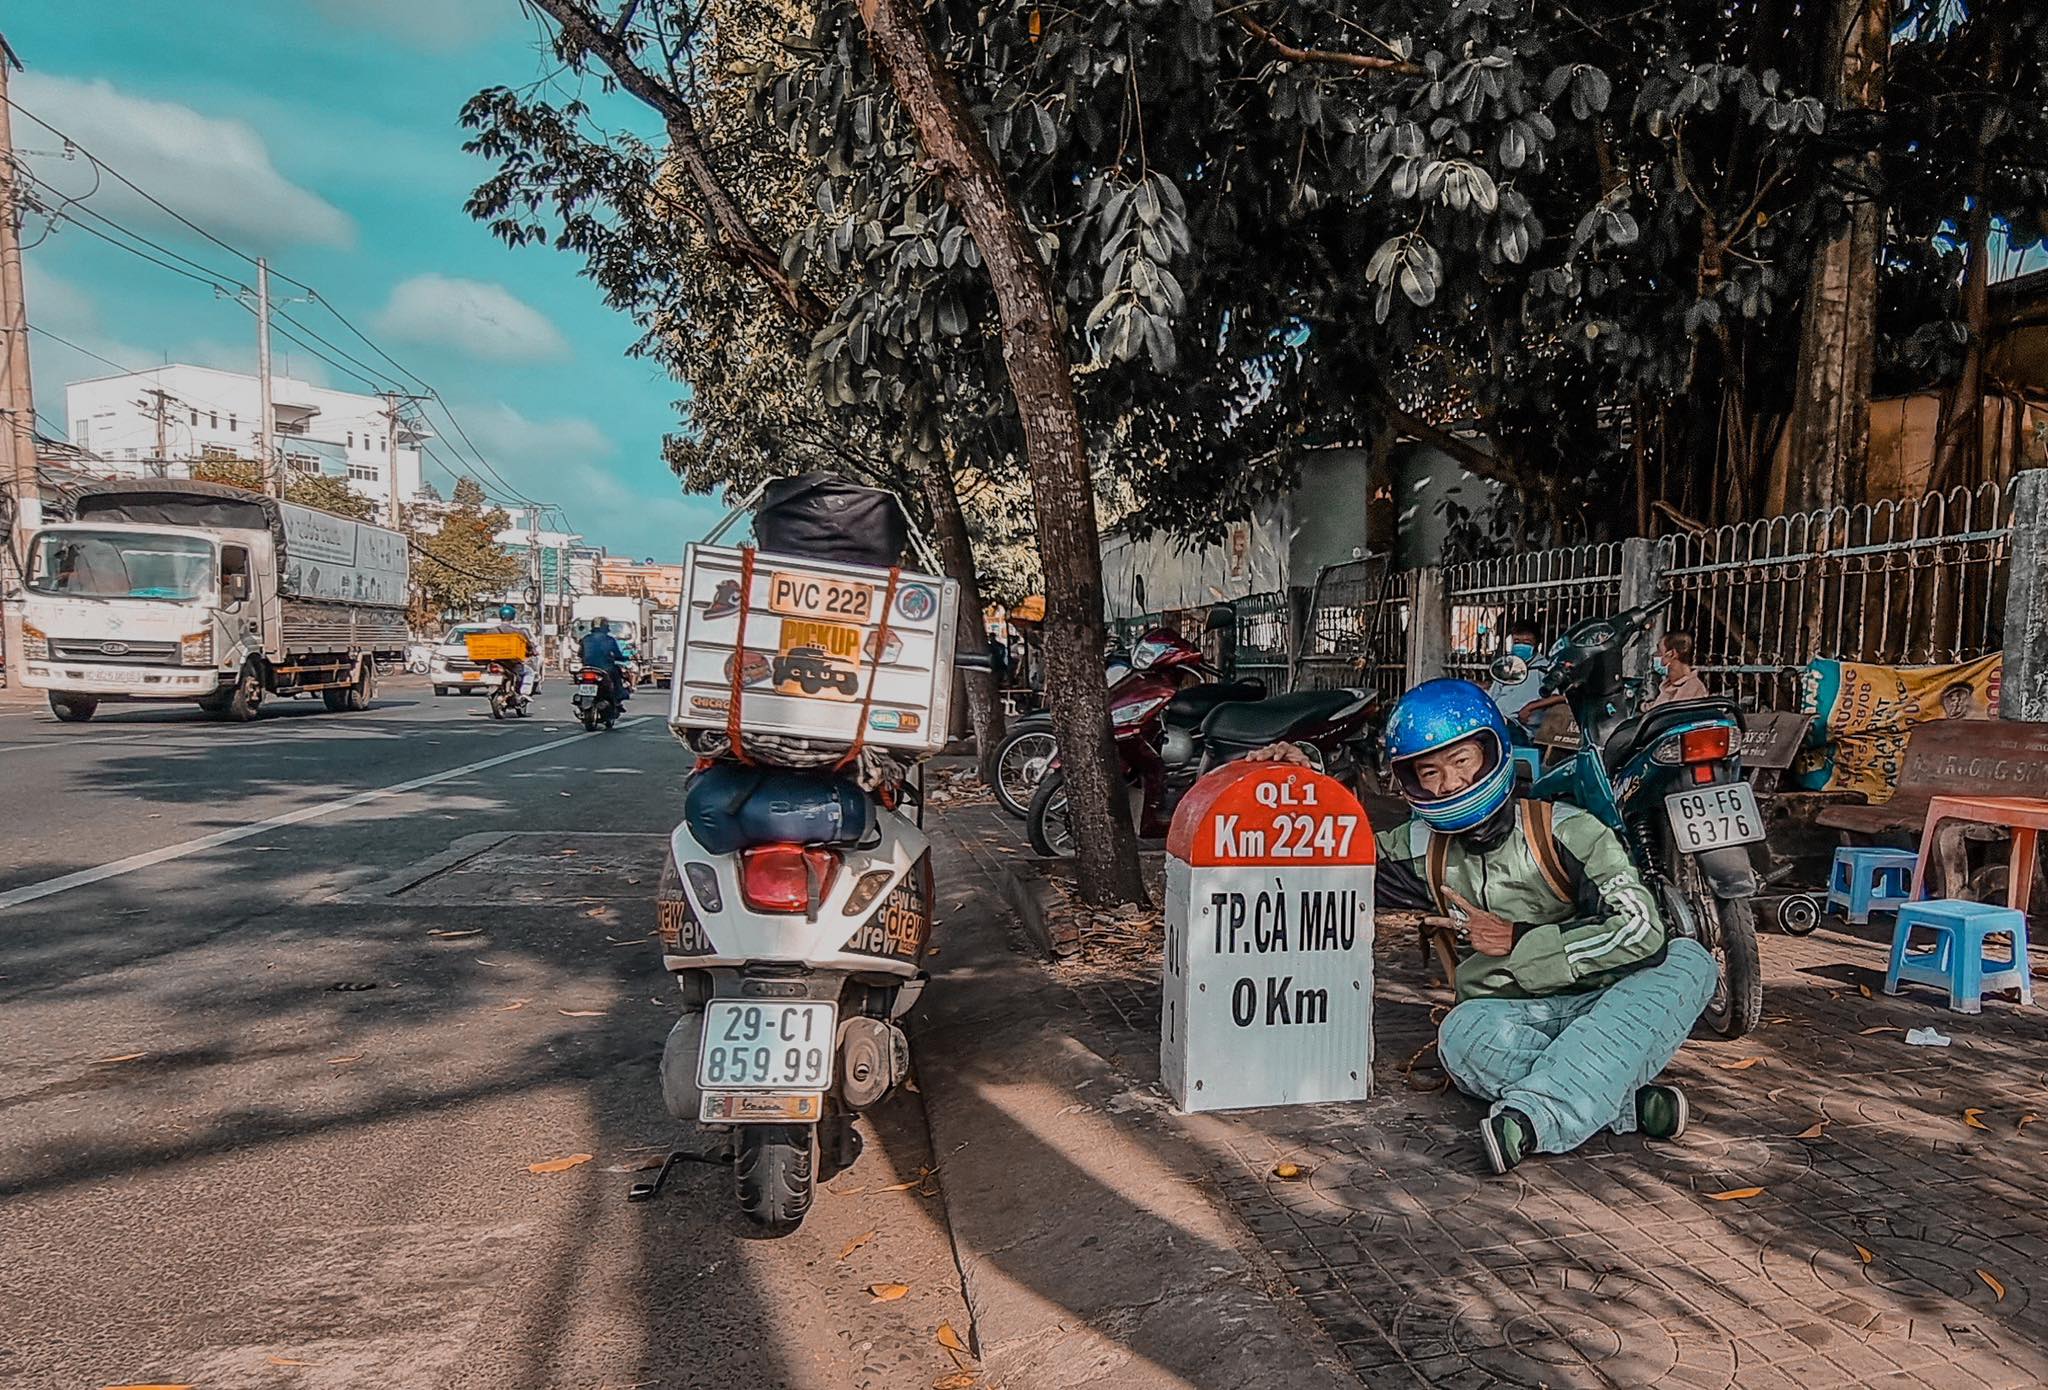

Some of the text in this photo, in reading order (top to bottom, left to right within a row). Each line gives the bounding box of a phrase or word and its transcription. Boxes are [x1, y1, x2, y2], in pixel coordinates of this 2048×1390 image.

[776, 580, 867, 615] PVC 222
[782, 621, 860, 656] PICKUP
[791, 668, 847, 682] CLUB
[691, 696, 731, 709] CHICAG
[1680, 789, 1742, 820] 69-F6
[1215, 815, 1358, 858] Km 2247
[1687, 815, 1750, 846] 6376
[1299, 890, 1357, 951] MAU
[723, 1006, 814, 1042] 29-C1
[707, 1047, 823, 1083] 859.99
